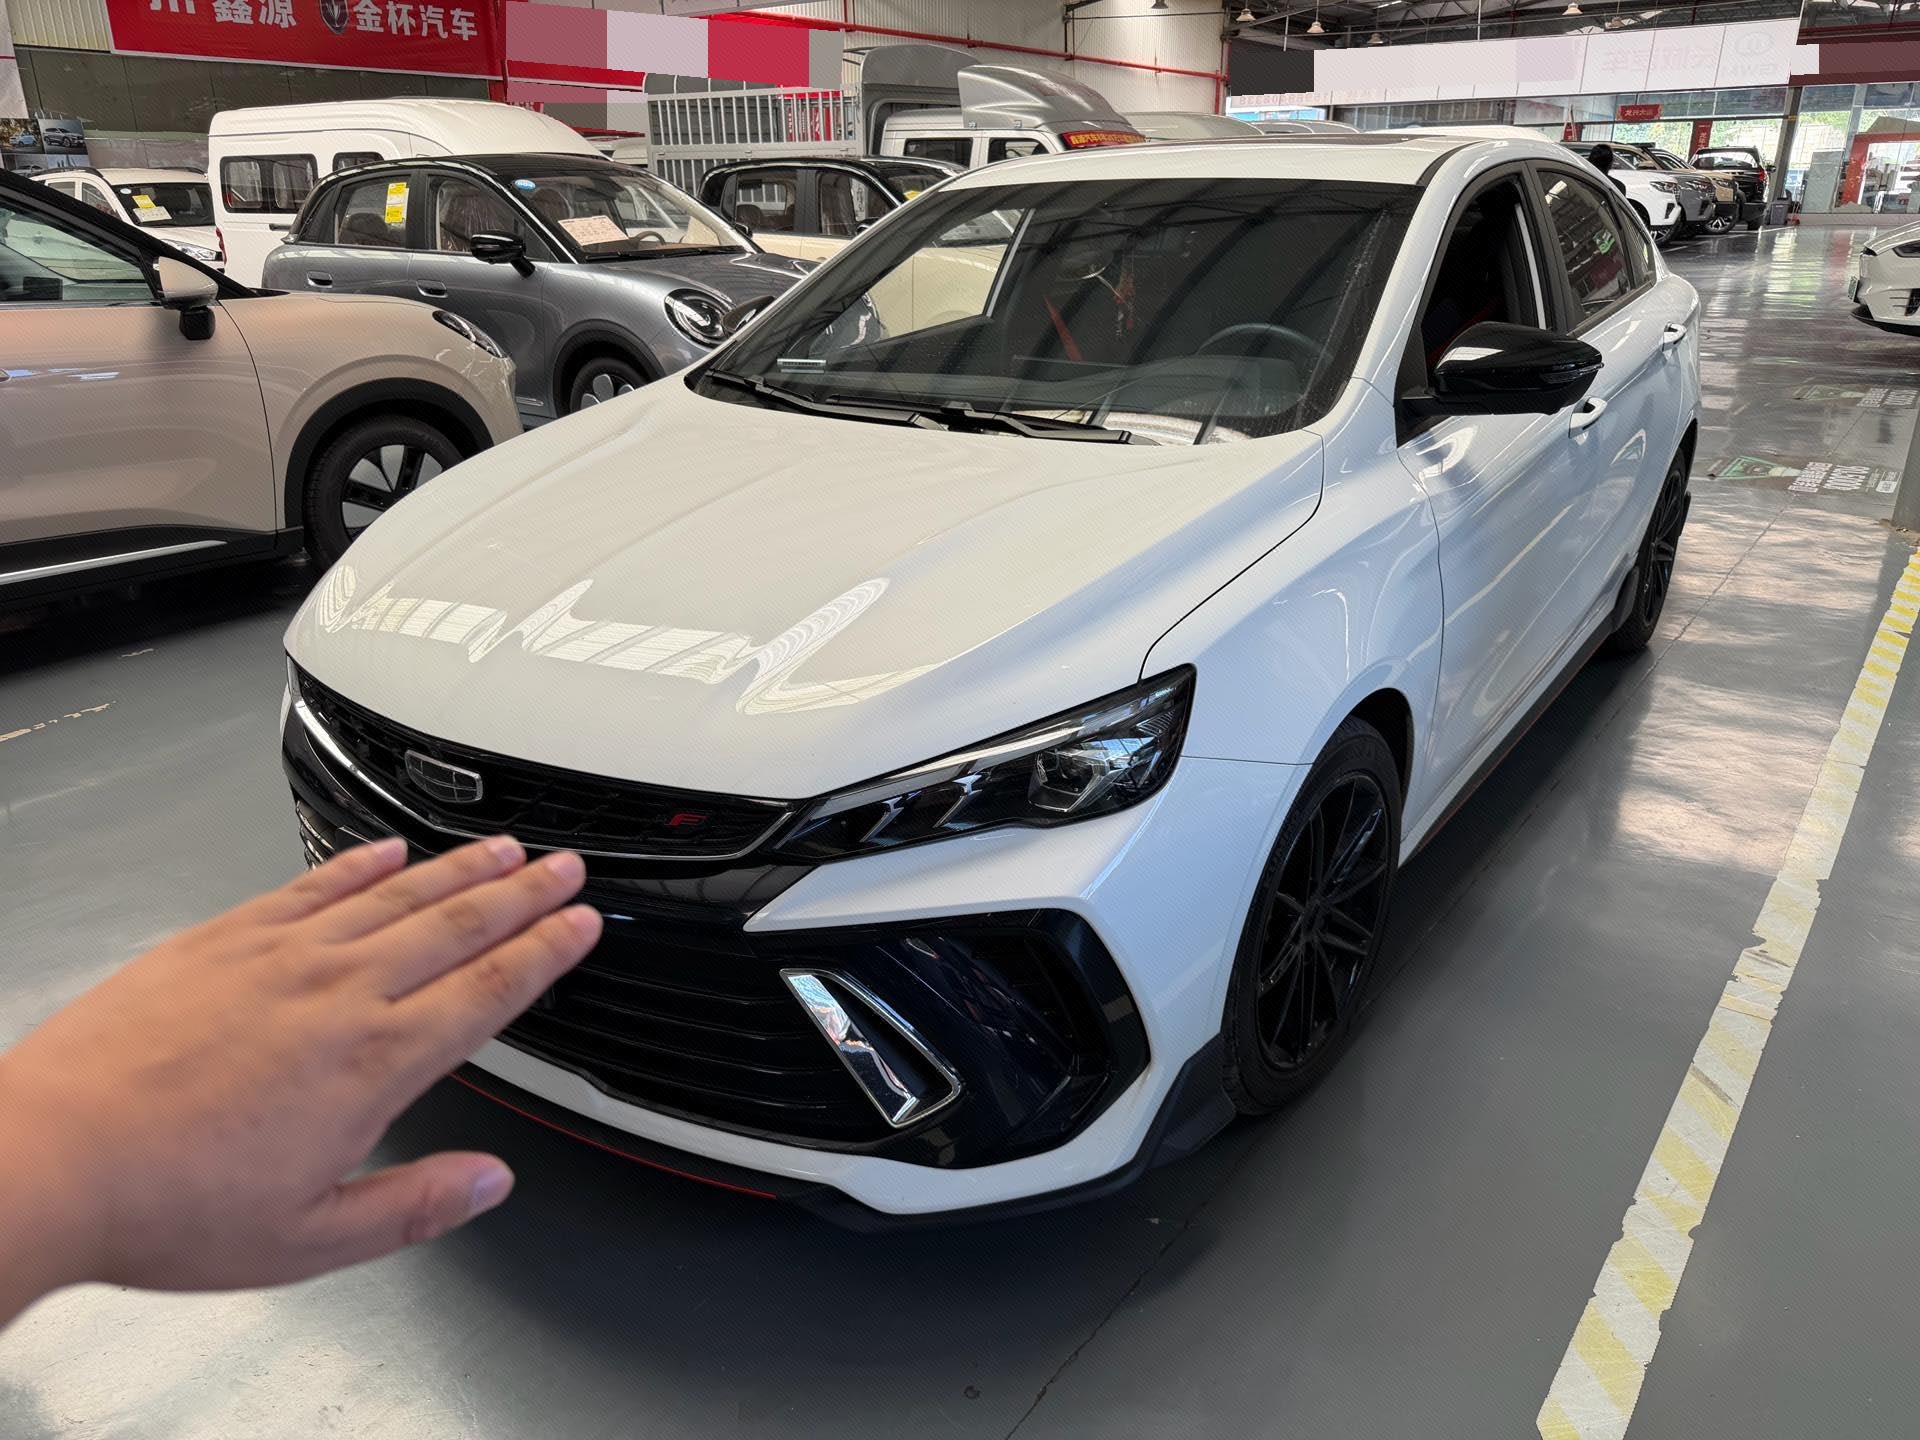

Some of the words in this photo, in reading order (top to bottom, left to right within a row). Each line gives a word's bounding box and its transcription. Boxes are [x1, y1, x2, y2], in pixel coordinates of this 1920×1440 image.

[212, 0, 297, 29] 鑫源
[353, 0, 478, 41] 金杯汽车
